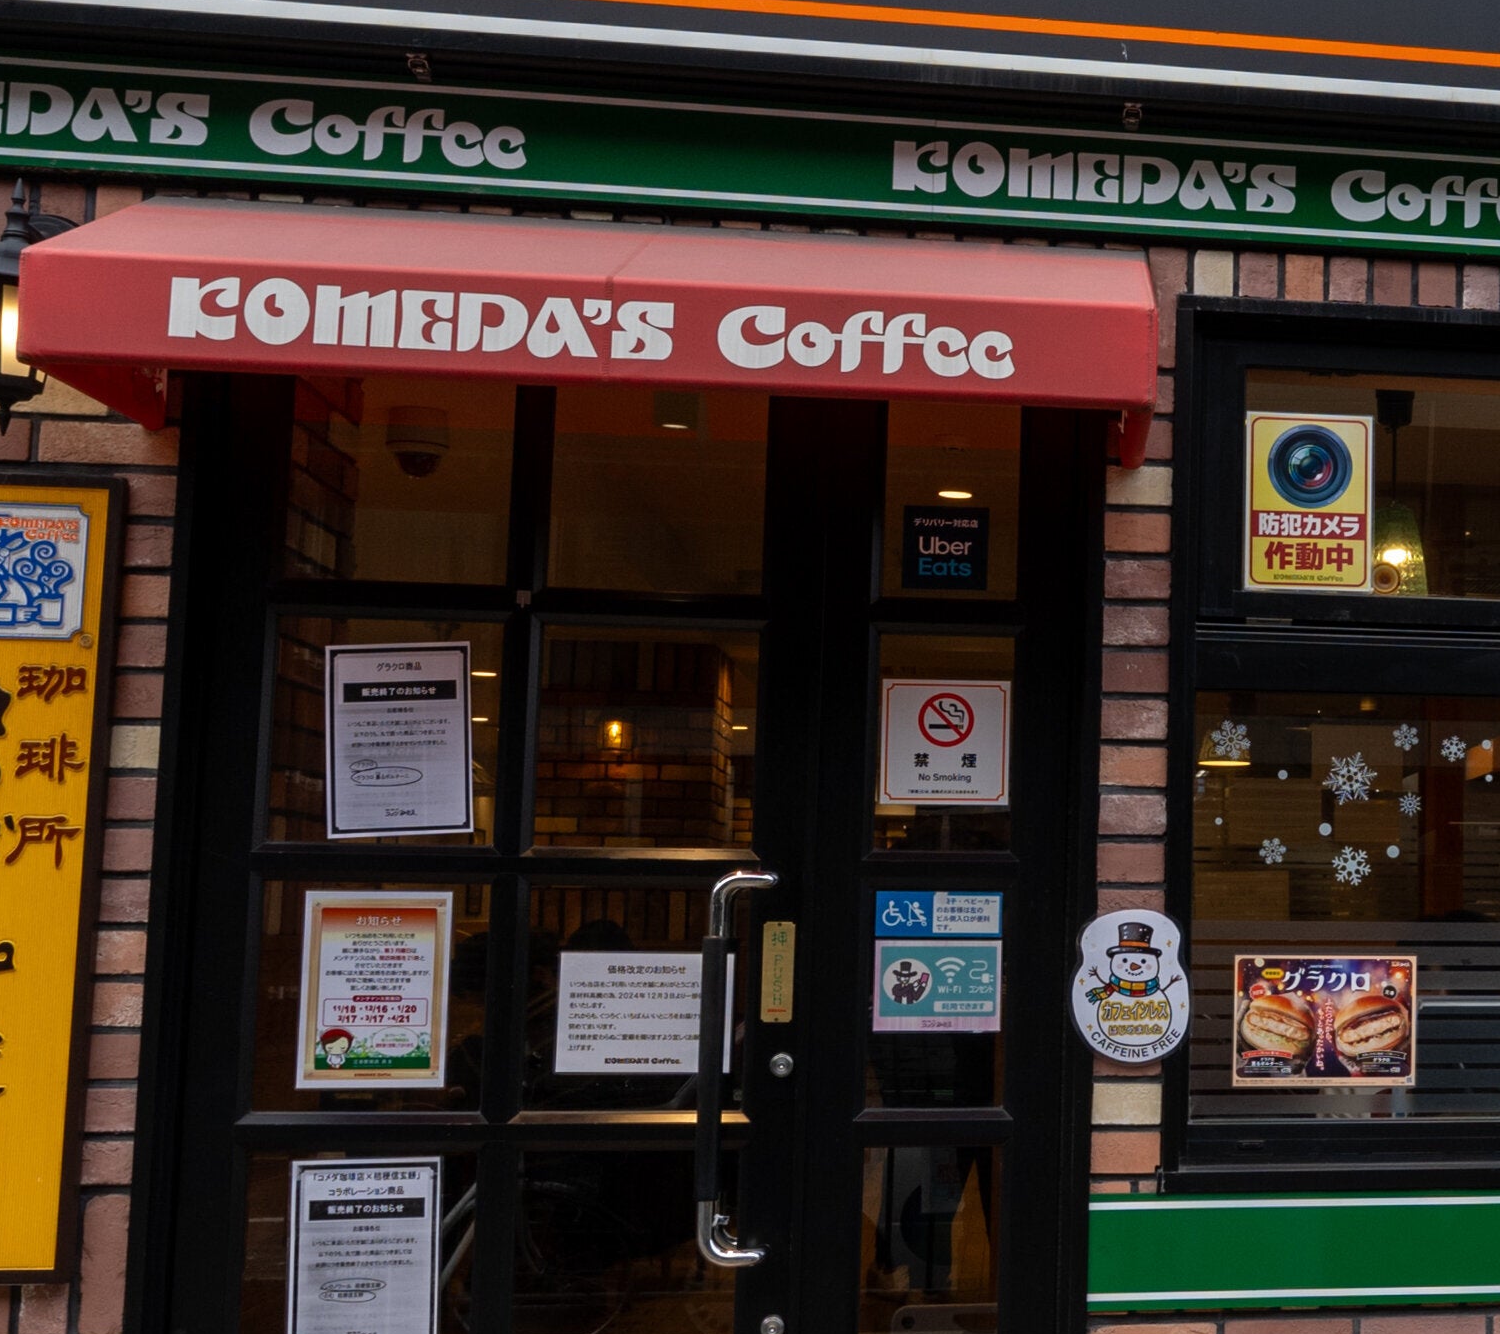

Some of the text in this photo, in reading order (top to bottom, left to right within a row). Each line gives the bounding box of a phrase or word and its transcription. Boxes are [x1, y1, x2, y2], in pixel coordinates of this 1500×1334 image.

[248, 98, 528, 172] Coffee
[890, 139, 1297, 217] KOMEDA'S
[167, 274, 1016, 387] KOMEDA'S Coffee
[913, 518, 979, 529] デリバリー対応店
[1258, 512, 1360, 537] 防犯カメラ
[24, 528, 79, 543] Coffee
[918, 535, 972, 555] Uber
[1264, 541, 1354, 572] 作動中
[918, 557, 972, 577] Eats
[376, 661, 423, 672] グラクロ商品
[361, 687, 437, 697] 販売終了のお知らせ
[5, 665, 88, 870] 珈琲所
[918, 772, 972, 784] No Smoking
[355, 916, 403, 927] お知らせ
[771, 931, 788, 946] 押
[607, 964, 687, 975] 価格改定のお知らせ
[772, 954, 784, 1005] PUSH
[1283, 968, 1372, 992] グラクロ
[937, 985, 962, 994] Wi-Fi
[968, 986, 995, 994] コンセント
[1101, 1001, 1169, 1020] カフェインレス
[1091, 1027, 1181, 1059] CAFFEINE FREE
[328, 1186, 405, 1196] コラボレーション商品
[327, 1204, 404, 1215] 販売終了のお知らせ
